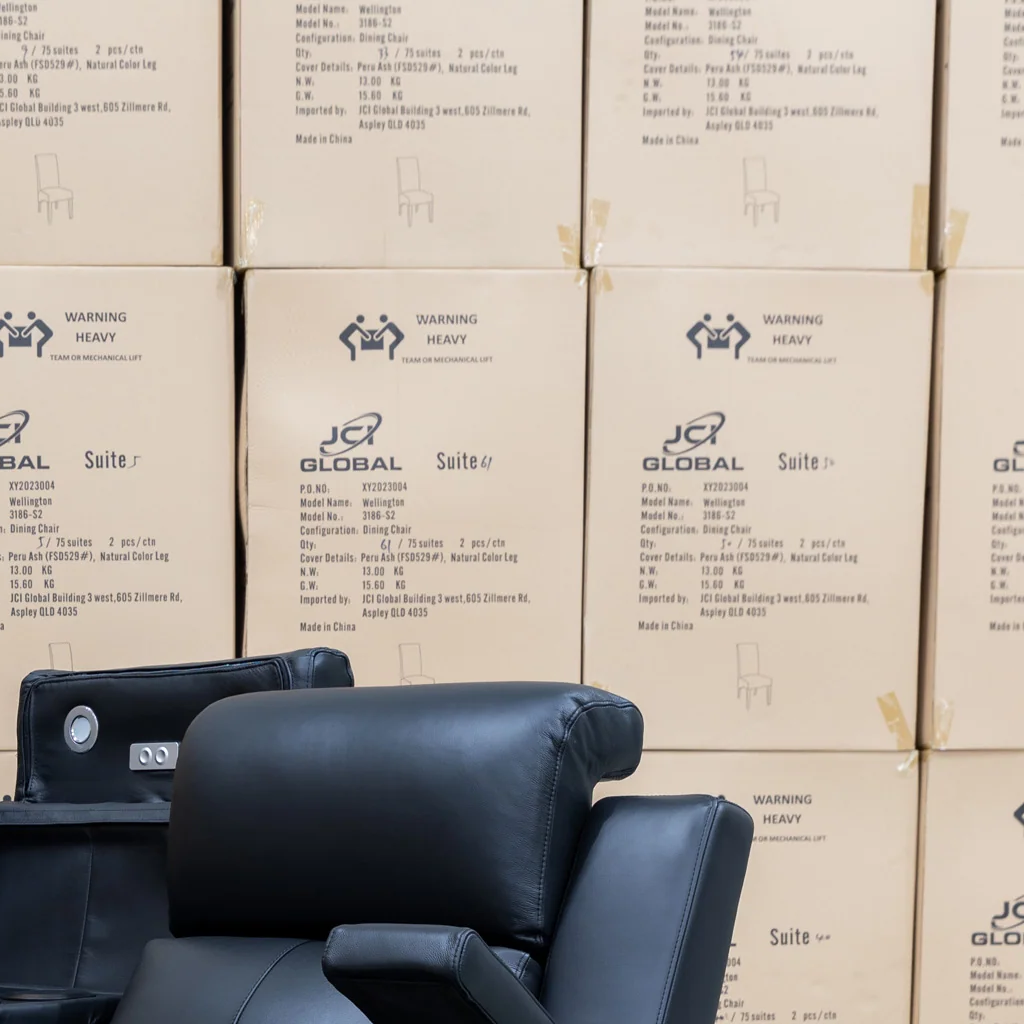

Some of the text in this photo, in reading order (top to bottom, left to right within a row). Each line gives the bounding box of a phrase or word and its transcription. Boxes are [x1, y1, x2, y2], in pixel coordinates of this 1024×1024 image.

[295, 134, 353, 145] Made in China
[64, 311, 127, 323] WARNING
[416, 314, 478, 325] WARNING
[762, 314, 824, 325] WARNING
[75, 332, 116, 343] HEAVY
[426, 334, 467, 345] HEAVY
[772, 334, 813, 345] HEAVY
[84, 451, 126, 469] Suite
[300, 457, 401, 472] GLOBAL
[436, 452, 478, 470] Suite
[642, 457, 743, 471] GLOBAL
[778, 453, 819, 471] Suite
[300, 498, 324, 508] Model
[362, 497, 405, 508] Wellington
[10, 524, 36, 535] Dining
[37, 524, 59, 534] Chair
[11, 606, 78, 618] Aspley QLD 4035
[700, 607, 767, 618] Aspley QLD 4035
[300, 622, 356, 632] Made in China
[752, 794, 813, 805] WARNING
[762, 813, 802, 824] HEAVY
[770, 928, 810, 946] Suite
